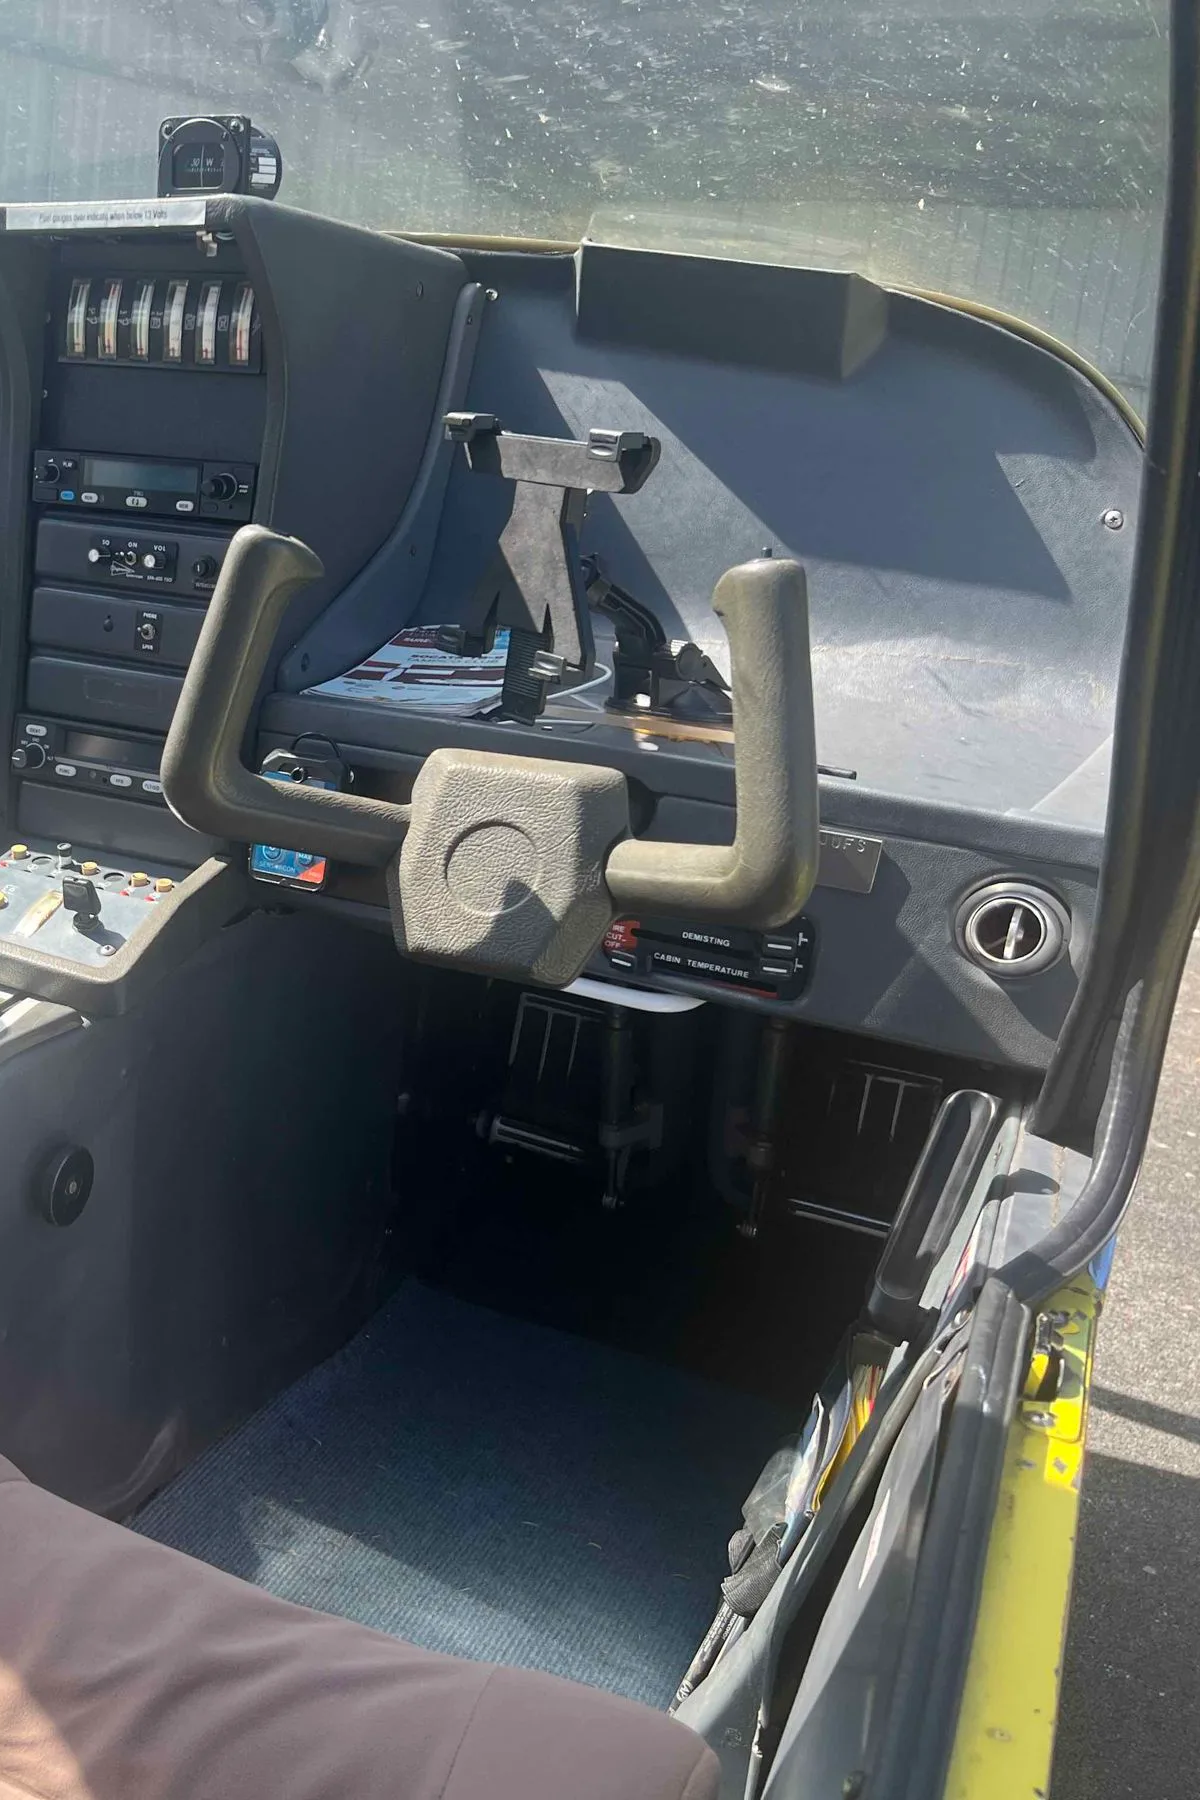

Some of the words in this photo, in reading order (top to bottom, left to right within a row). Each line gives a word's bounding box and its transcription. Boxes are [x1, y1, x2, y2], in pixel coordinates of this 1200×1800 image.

[206, 158, 214, 166] W
[110, 210, 125, 220] when
[153, 208, 168, 219] Volts
[612, 925, 626, 933] IRE
[682, 931, 731, 947] DEMISTING
[604, 940, 621, 949] OFF
[653, 952, 681, 964] CABIN
[687, 959, 749, 979] TEMPERATURE
